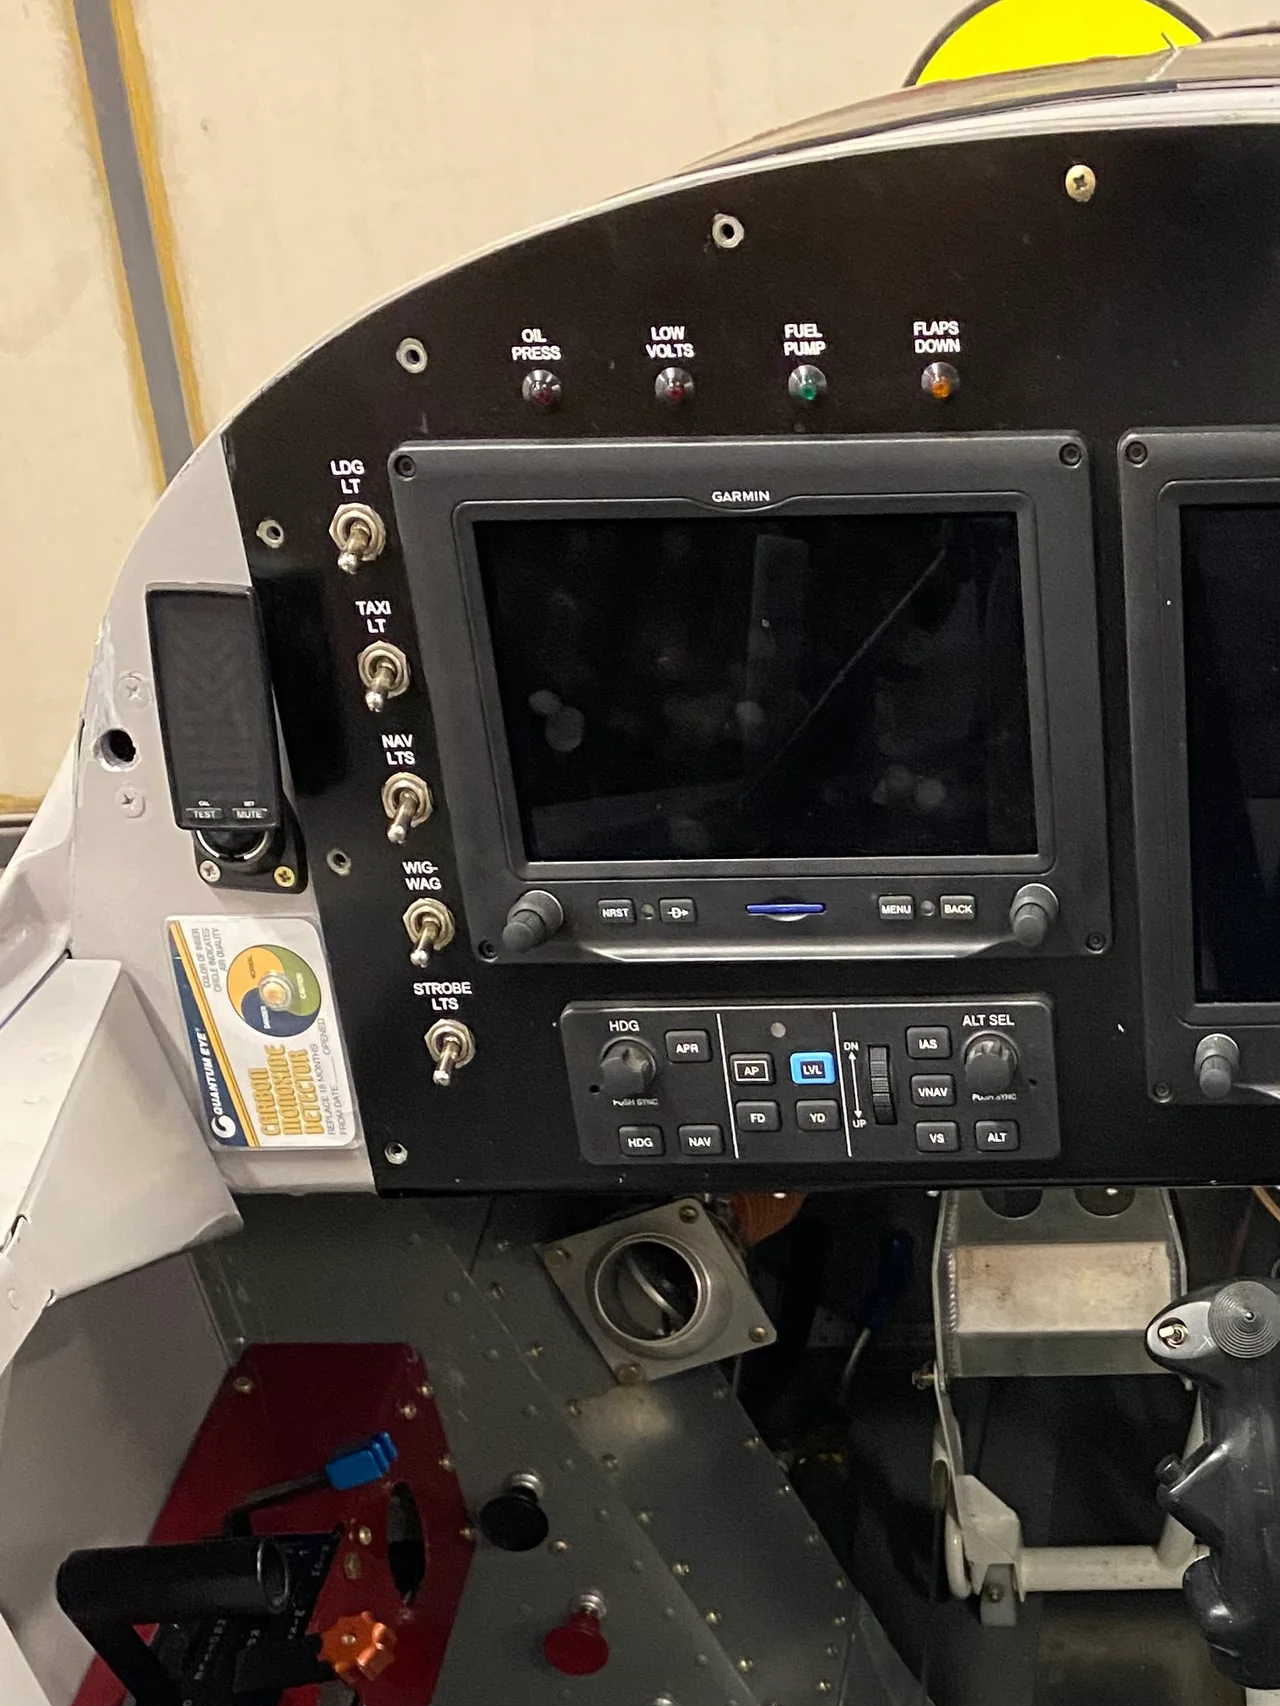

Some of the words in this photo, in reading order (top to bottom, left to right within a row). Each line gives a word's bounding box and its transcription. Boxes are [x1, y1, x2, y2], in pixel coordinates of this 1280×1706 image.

[651, 326, 685, 340] LOW
[785, 324, 823, 338] FUEL
[914, 321, 959, 336] FLAPS
[522, 329, 547, 343] OIL
[646, 343, 694, 358] VOLTS
[784, 341, 826, 356] PUMP
[915, 338, 960, 353] DOWN
[512, 346, 561, 360] PRESS
[331, 460, 364, 475] LDG
[341, 479, 360, 494] LT
[712, 491, 769, 502] GARMIN
[355, 601, 391, 615] TAXI
[367, 619, 386, 633] LT
[382, 734, 412, 748] NAV
[387, 751, 415, 765] LTS
[193, 811, 216, 819] TEST
[236, 811, 262, 819] MUTE
[403, 861, 438, 874] WIG-
[405, 877, 441, 890] WAG
[603, 908, 628, 917] NRST
[882, 905, 911, 914] MENU
[945, 905, 972, 913] BACK
[202, 928, 217, 966] INDICATES
[211, 928, 225, 957] QUALITY
[199, 963, 211, 988] COLOR
[209, 967, 223, 992] CIRCLE
[299, 973, 308, 999] CAUTION
[414, 982, 472, 995] STROBE
[432, 997, 459, 1010] LTS
[609, 1020, 639, 1031] HDG
[963, 1015, 985, 1026] ALT
[989, 1014, 1014, 1025] SEL
[318, 1018, 331, 1055] OPENED
[676, 1044, 698, 1053] APR
[844, 1042, 858, 1050] DN
[919, 1039, 937, 1049] IAS
[310, 1044, 325, 1082] MONTHS
[803, 1065, 822, 1075] LVL
[745, 1067, 759, 1075] AP
[204, 1057, 223, 1115] QUANTUM
[266, 1045, 302, 1135] MONOXIDE
[290, 1049, 325, 1135] DETECTOR
[918, 1088, 947, 1097] VNAV
[249, 1069, 281, 1136] CARBON
[331, 1085, 343, 1109] DATE
[321, 1095, 336, 1135] REPLACE
[751, 1114, 765, 1122] FD
[810, 1113, 825, 1122] YD
[334, 1110, 348, 1135] FROM
[853, 1119, 866, 1127] UP
[628, 1138, 653, 1147] HDG
[689, 1137, 711, 1146] NAV
[930, 1134, 944, 1143] VS
[988, 1133, 1006, 1142] ALT
